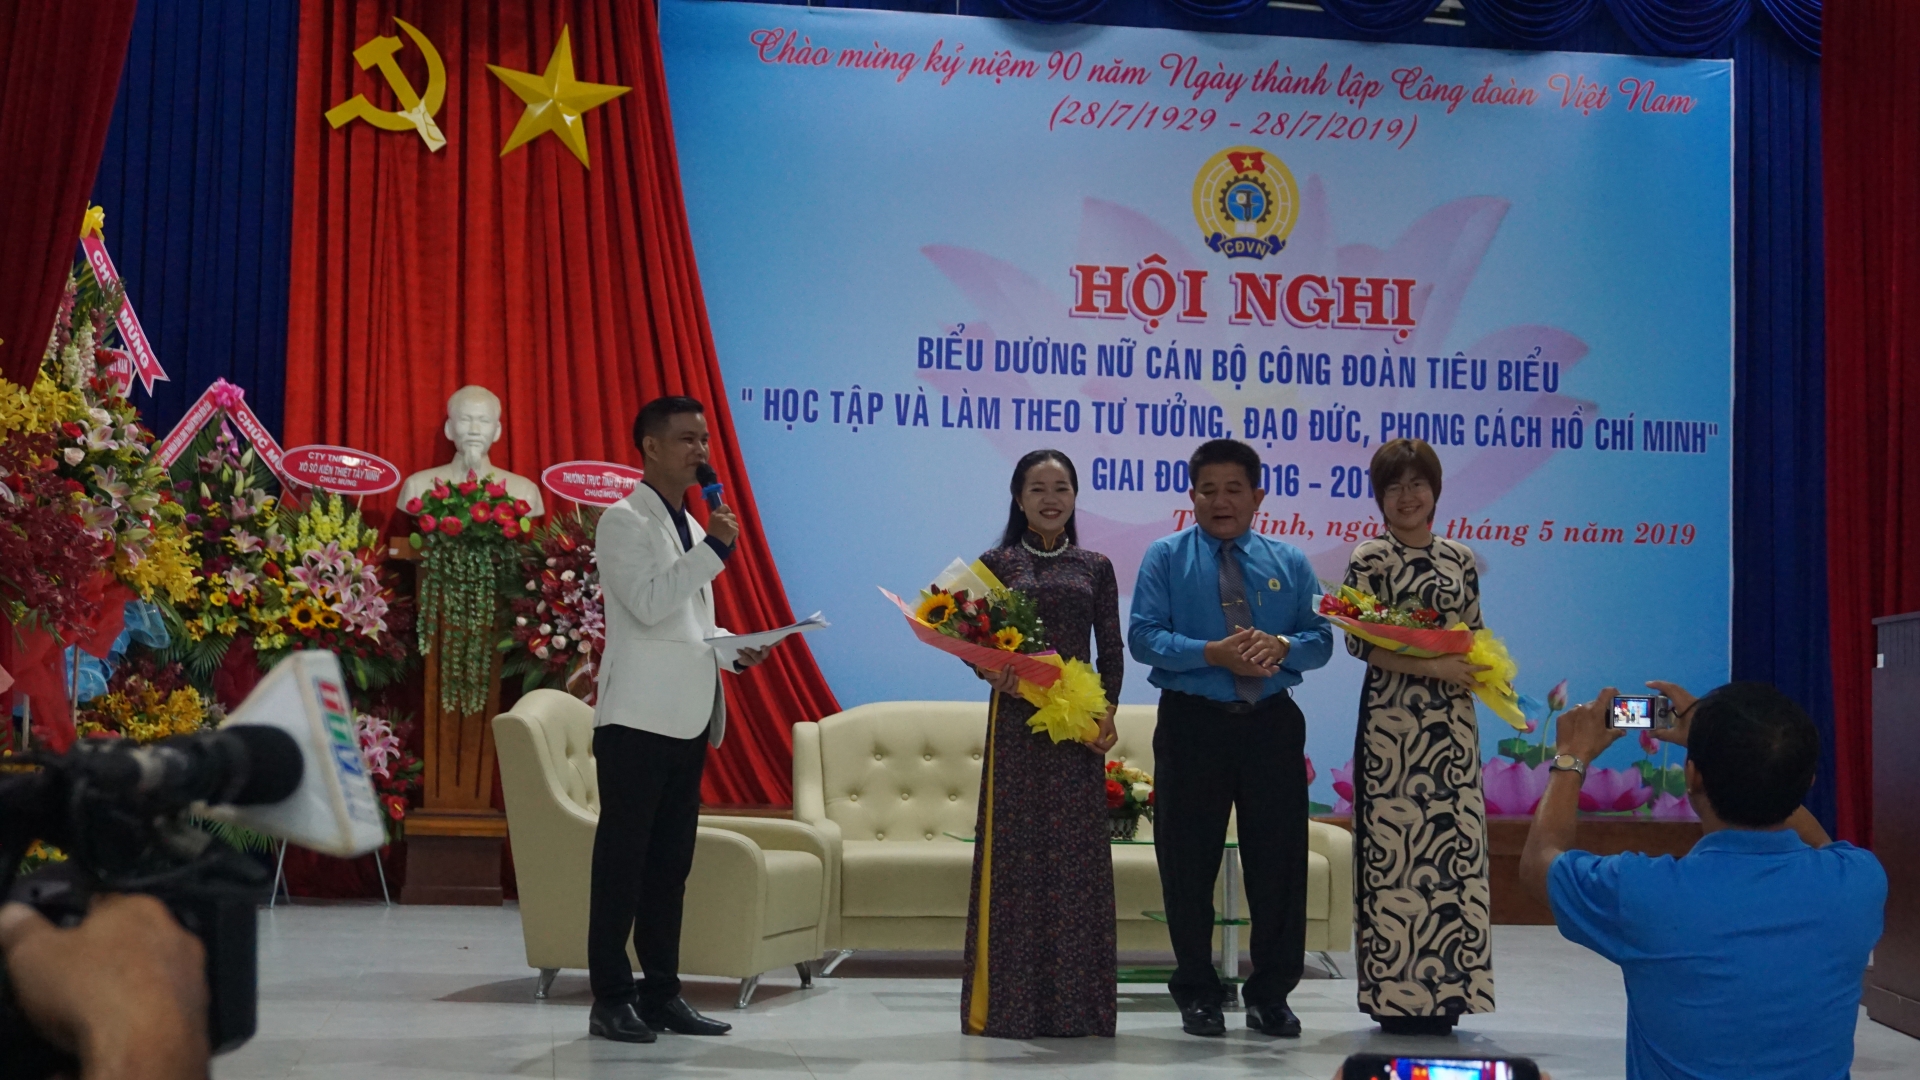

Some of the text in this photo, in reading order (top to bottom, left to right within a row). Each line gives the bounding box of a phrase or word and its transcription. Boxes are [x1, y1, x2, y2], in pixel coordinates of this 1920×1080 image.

[750, 28, 1697, 117] Chào mừng kỷ niệm 90 năm Ngày thành lập Công đoàn Việt Nam
[1049, 95, 1217, 131] (28/7/1929
[1249, 110, 1418, 148] 28/7/2019)
[1224, 240, 1267, 256] CĐVN
[1073, 253, 1416, 341] HỘI NGHỊ
[918, 323, 1558, 393] BIỂU DƯƠNG NỮ CÁN BỘ CÔNG ĐOÀN TIÊU BIỂU
[764, 389, 818, 430] HỌC
[830, 385, 883, 432] TẬP
[895, 386, 929, 427] VÀ
[942, 388, 1000, 430] LÀM
[1012, 398, 1080, 433] THEO
[1092, 397, 1127, 435] TƯ
[1137, 391, 1232, 439] TƯỞNG,
[1244, 407, 1297, 448] ĐẠO
[1308, 402, 1369, 447] ĐỨC,
[1381, 412, 1464, 446] PHONG
[1475, 408, 1541, 448] CÁCH
[1552, 406, 1583, 449] HỒ
[1596, 413, 1633, 450] CHÍ
[1644, 421, 1717, 452] MINH"
[1092, 457, 1144, 491] GIAI
[1154, 460, 1189, 493] ĐO
[1262, 464, 1299, 497] 016
[1331, 466, 1374, 498] 201
[1326, 516, 1388, 543] ngà
[1447, 517, 1530, 547] tháng
[1537, 519, 1555, 543] 5
[1562, 521, 1625, 545] năm
[1633, 521, 1697, 547] 2019
